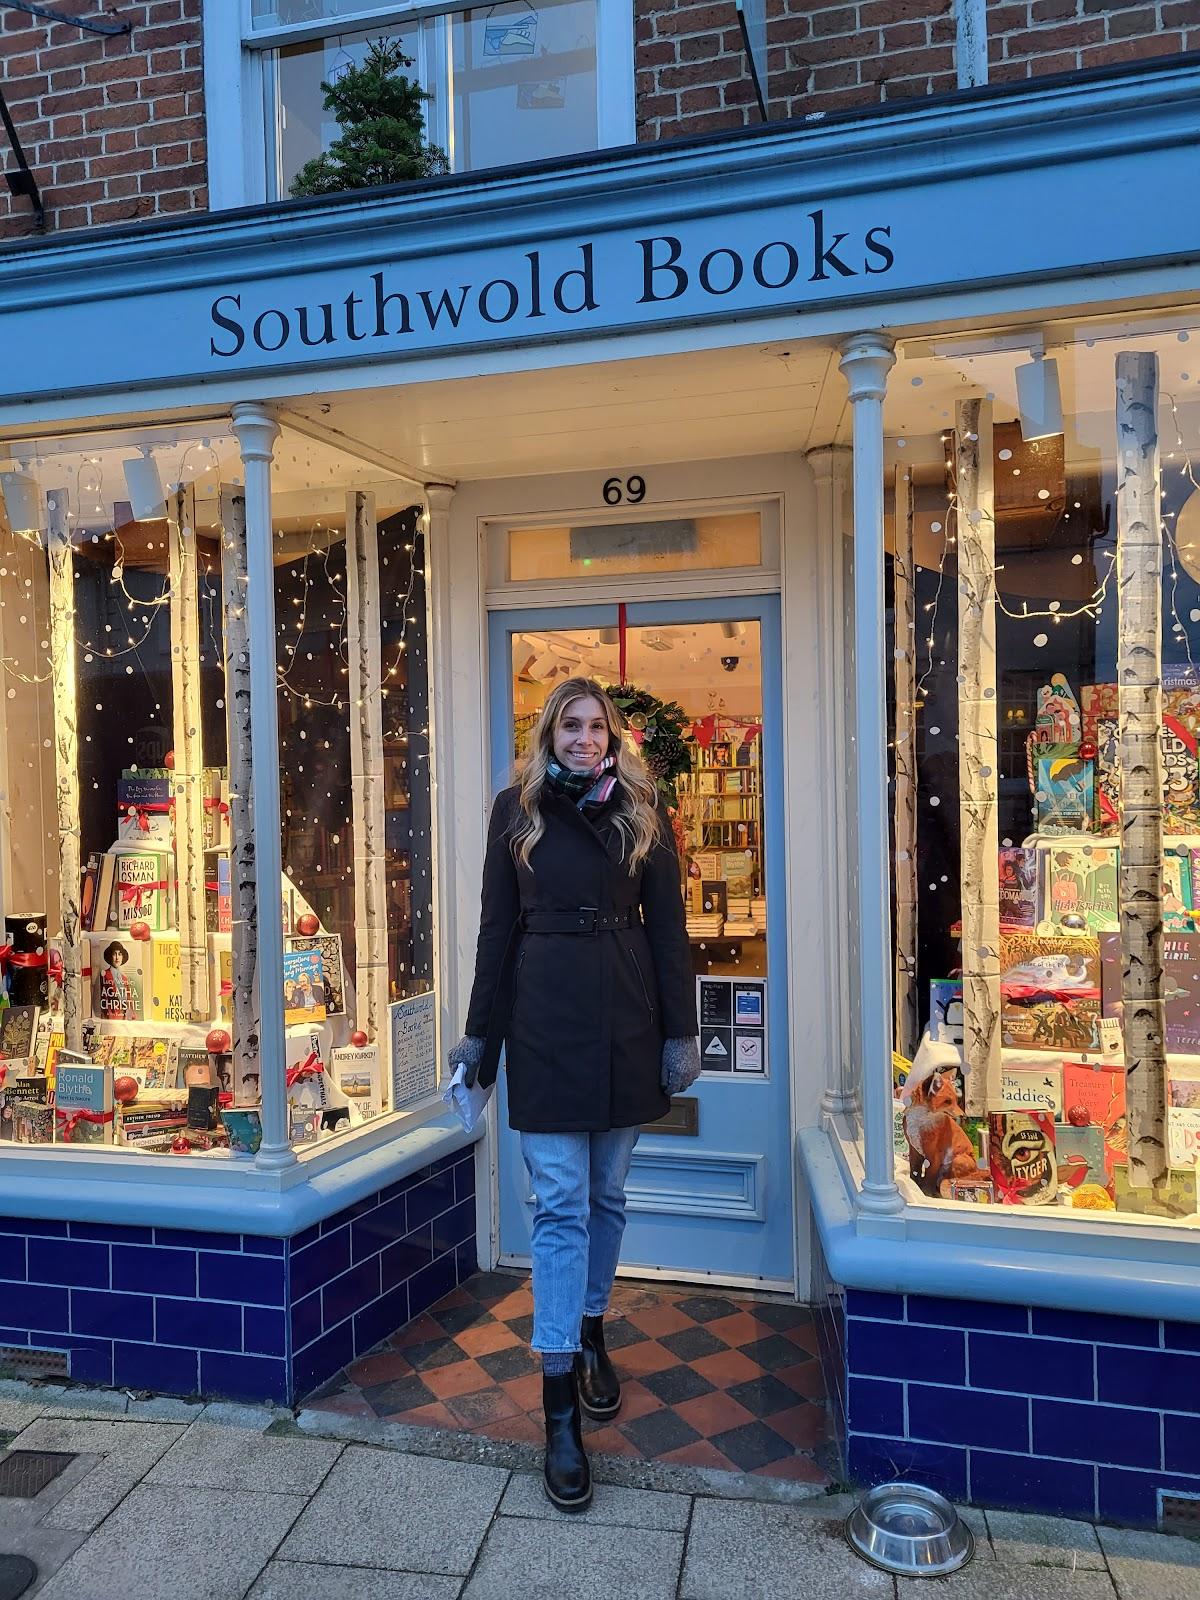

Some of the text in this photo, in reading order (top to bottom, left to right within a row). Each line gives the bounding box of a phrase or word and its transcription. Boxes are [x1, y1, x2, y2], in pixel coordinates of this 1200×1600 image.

[210, 209, 895, 357] Southwold Books
[602, 475, 647, 506] 69
[121, 872, 154, 882] OSMAN
[101, 986, 139, 998] AGATHA
[100, 999, 141, 1011] CHRISTIE
[58, 1072, 94, 1083] Ronald
[1001, 1076, 1018, 1086] The
[6, 1087, 40, 1095] Bennett
[58, 1083, 92, 1096] Blythe
[1015, 1158, 1048, 1180] TYGER
